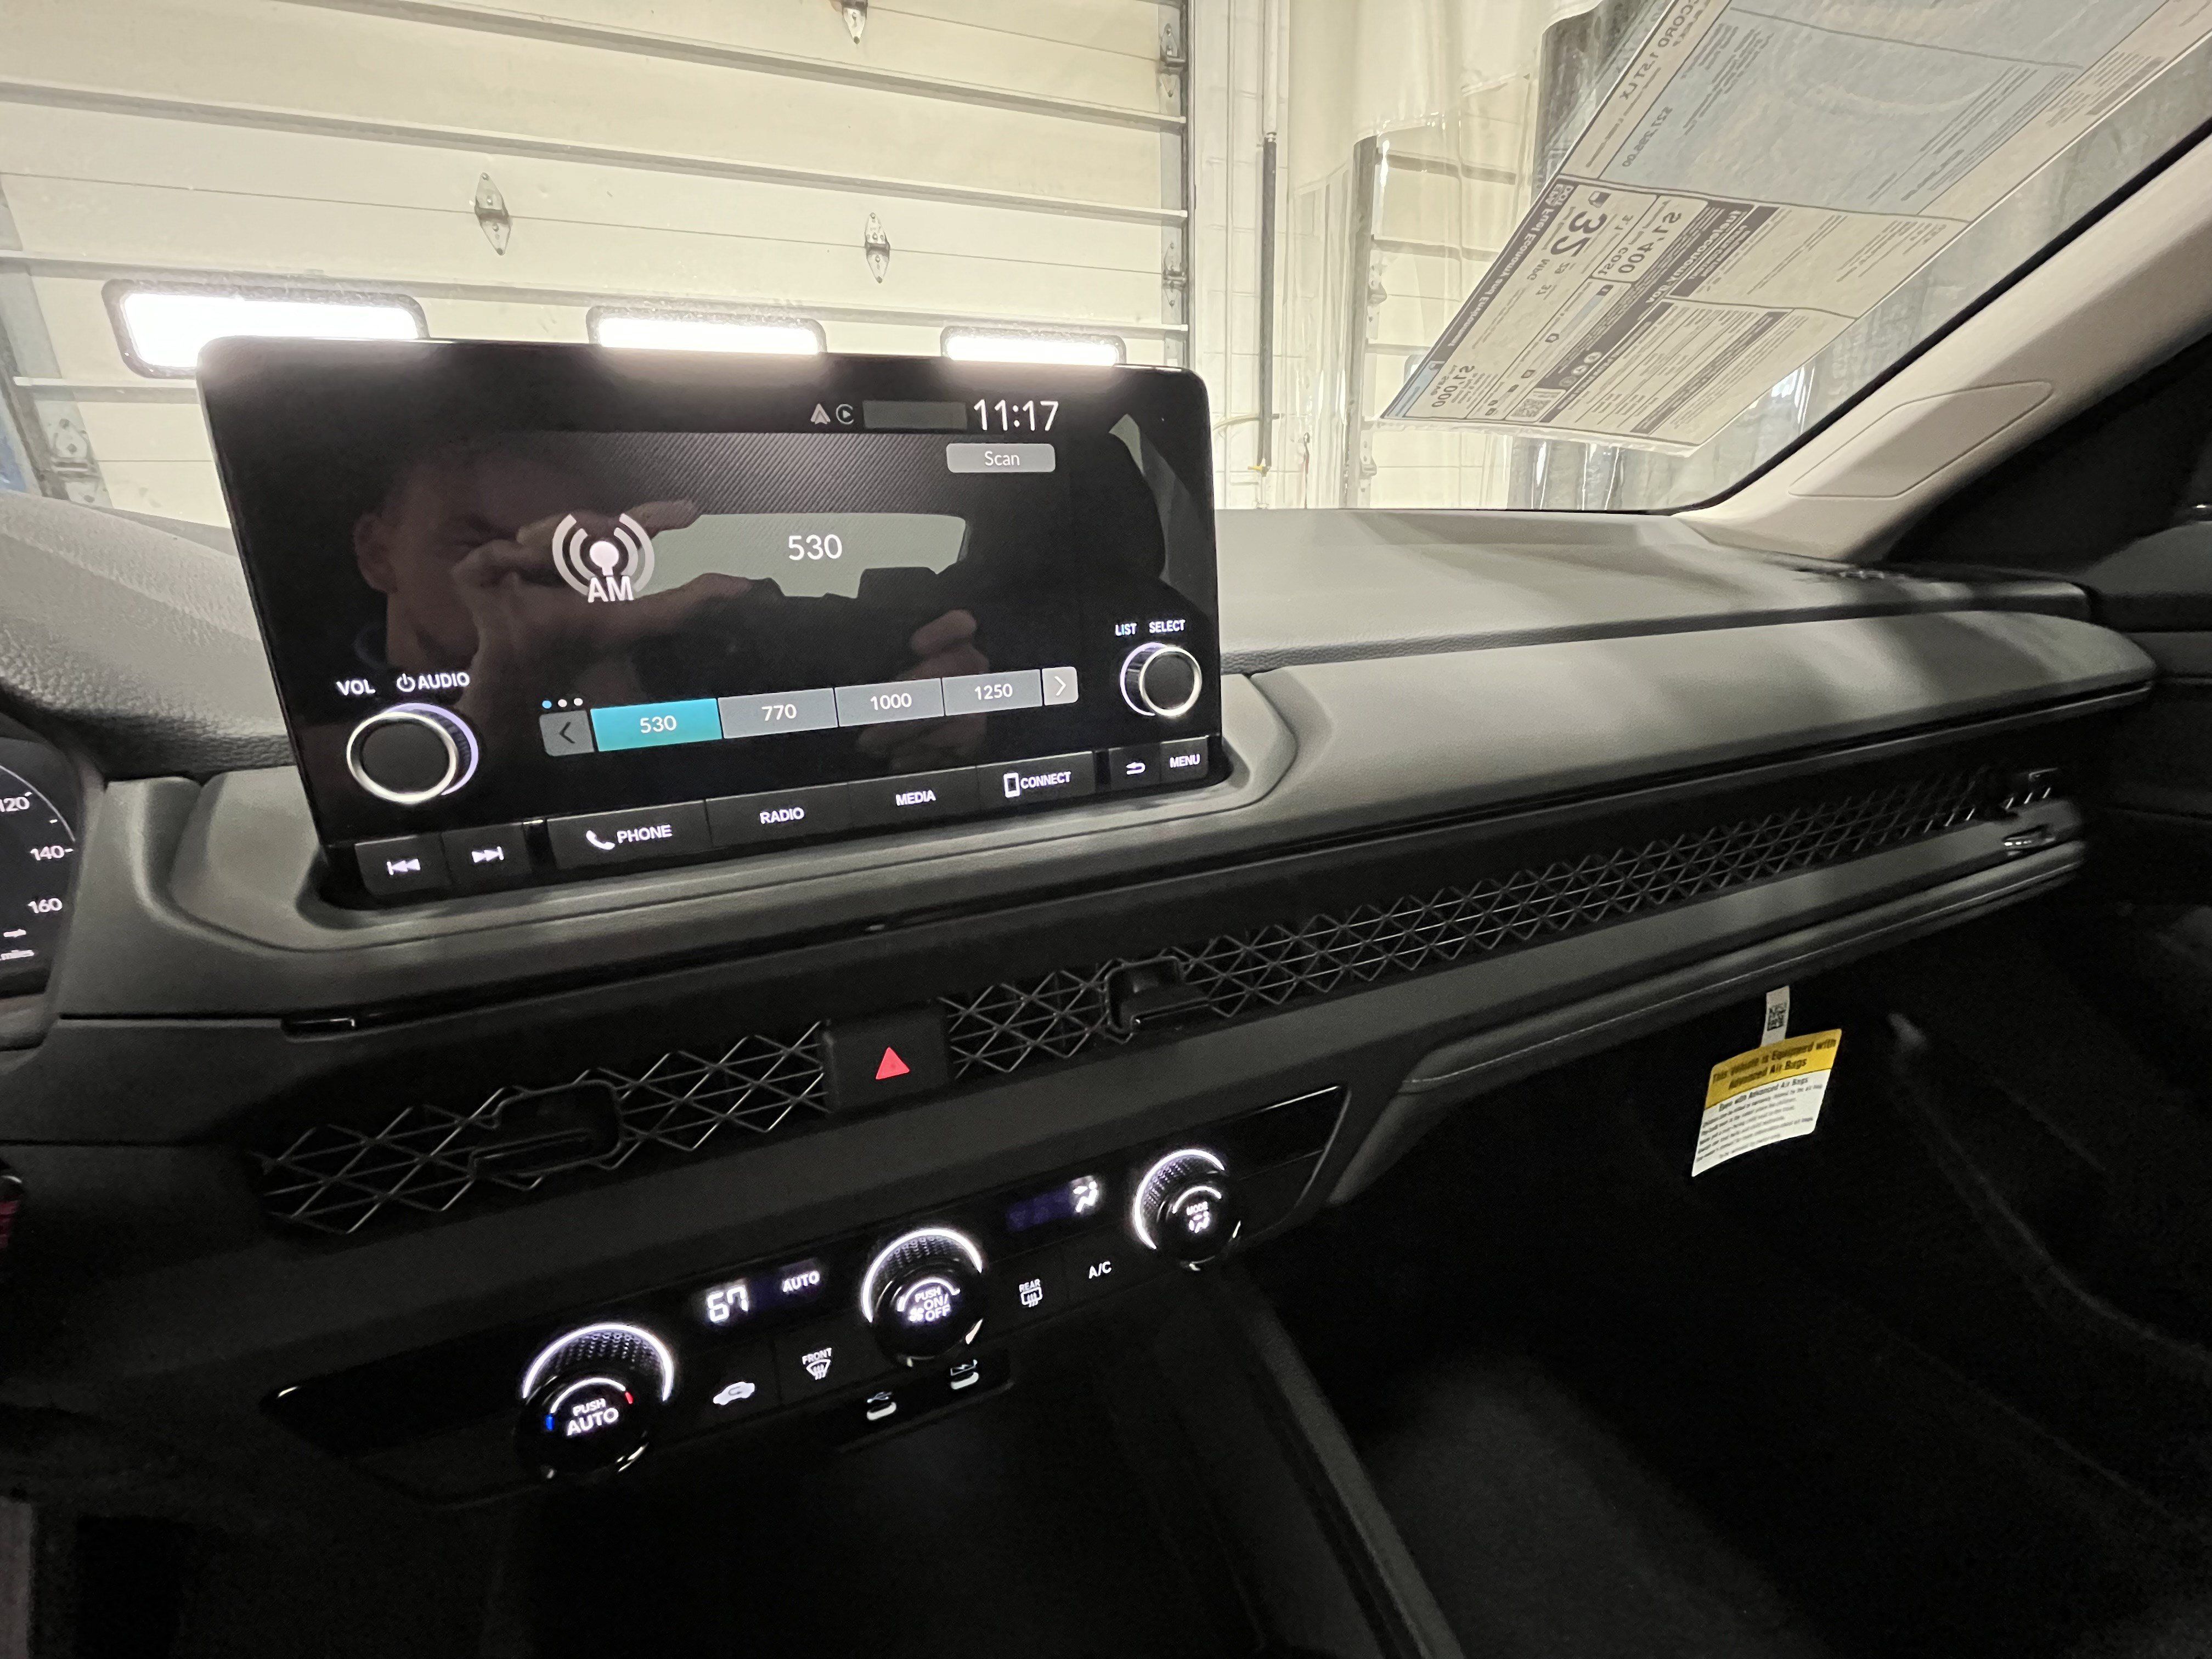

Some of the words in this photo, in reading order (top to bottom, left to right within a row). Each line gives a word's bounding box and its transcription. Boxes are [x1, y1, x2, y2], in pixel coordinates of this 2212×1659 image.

[974, 399, 1059, 431] 11:17
[984, 451, 1020, 466] Scan
[788, 534, 843, 560] 530
[588, 575, 634, 603] AM
[1115, 623, 1137, 636] LIST
[1149, 619, 1186, 633] SELECT
[336, 679, 375, 696] VOL
[417, 671, 471, 690] AUDIO
[640, 715, 677, 734] 530
[761, 704, 797, 722] 770
[870, 692, 912, 710] 1000
[974, 683, 1013, 701] 1250
[617, 824, 673, 844] PHONE
[759, 806, 805, 825] RADIO
[895, 789, 936, 807] MEDIA
[1020, 771, 1072, 789] CONNECT
[1170, 754, 1200, 768] MENU
[30, 844, 65, 861] 140
[27, 898, 63, 913] 160
[1088, 1261, 1113, 1279] A/C
[915, 1286, 941, 1302] PUSH
[1019, 1279, 1041, 1293] REAR
[706, 1285, 750, 1323] 67
[782, 1270, 821, 1293] AUTO
[925, 1305, 951, 1323] OFF
[802, 1347, 833, 1364] FRONT
[572, 1398, 606, 1417] PUSH
[566, 1407, 619, 1437] AUTO
